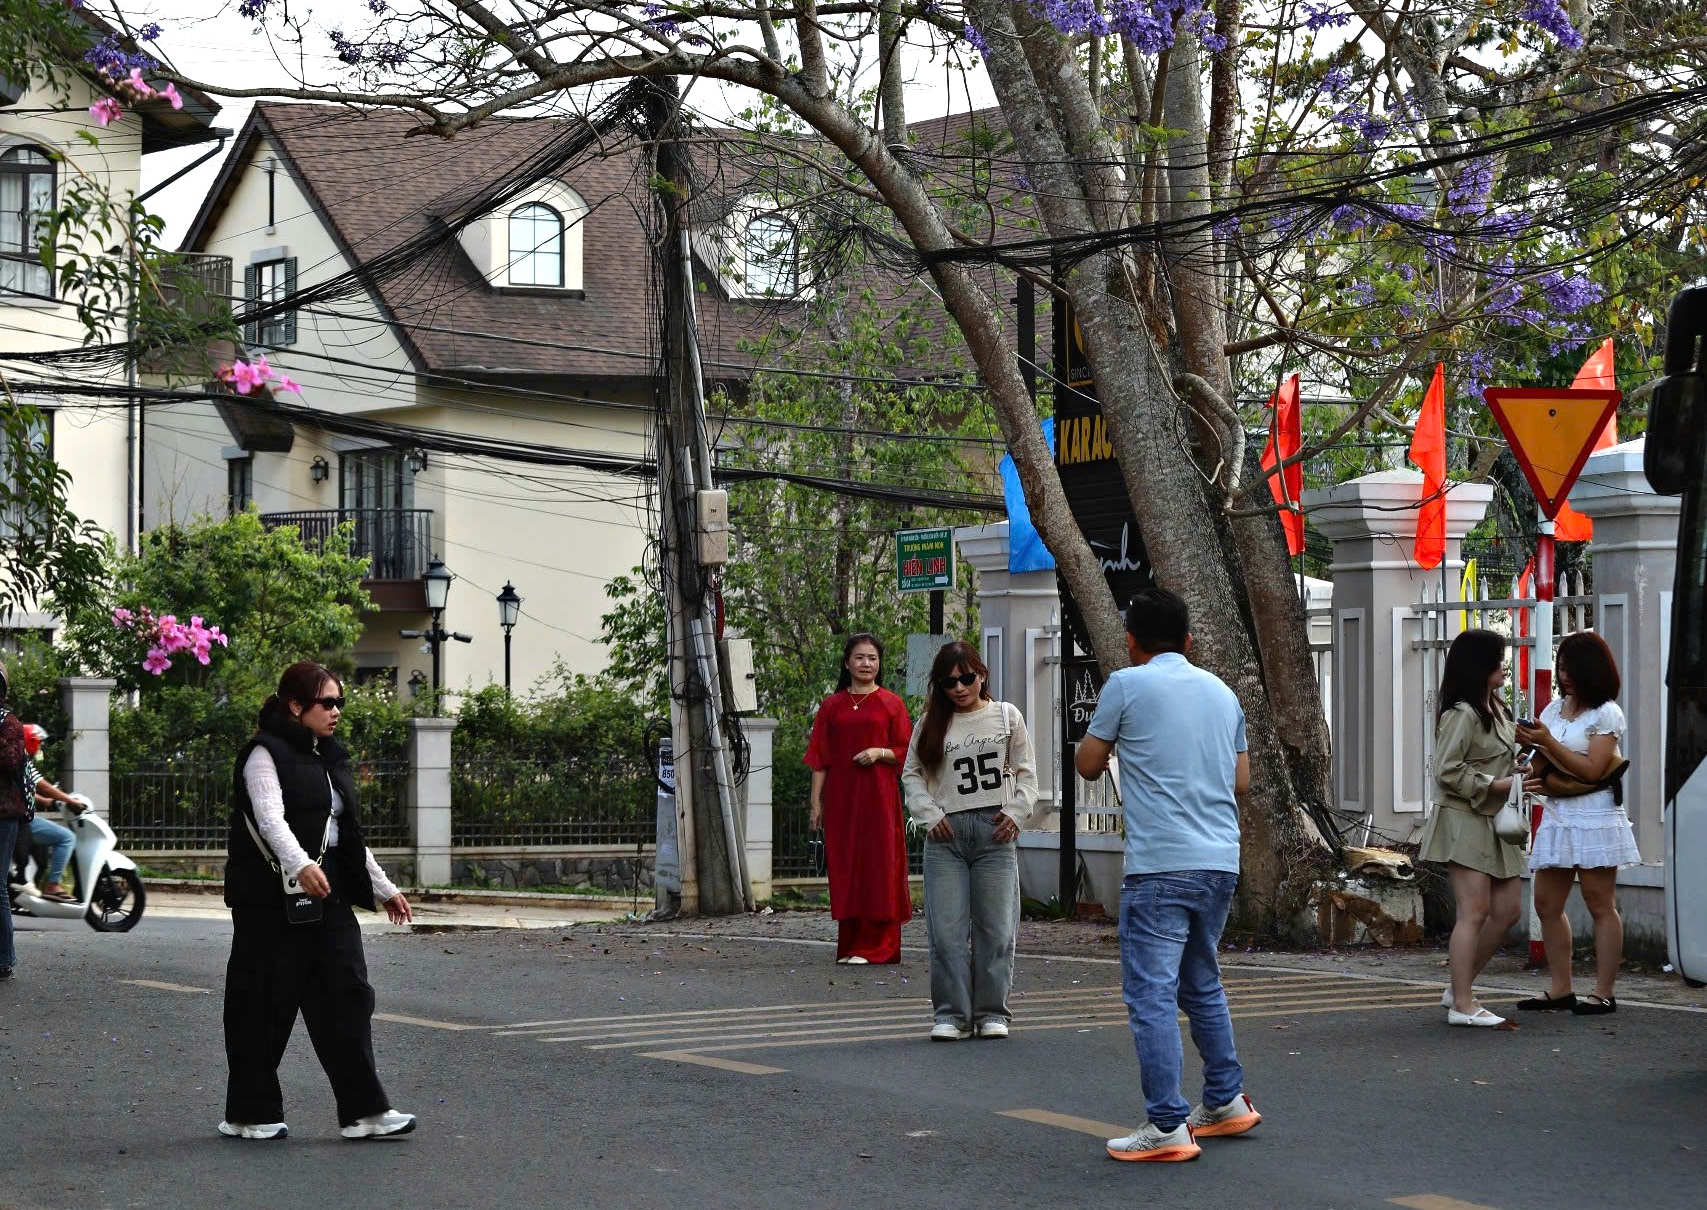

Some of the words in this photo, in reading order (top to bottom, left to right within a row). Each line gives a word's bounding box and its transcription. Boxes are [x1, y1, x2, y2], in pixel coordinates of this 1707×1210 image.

[1070, 366, 1091, 380] SINC
[926, 557, 946, 575] LINH
[953, 751, 1003, 795] 35
